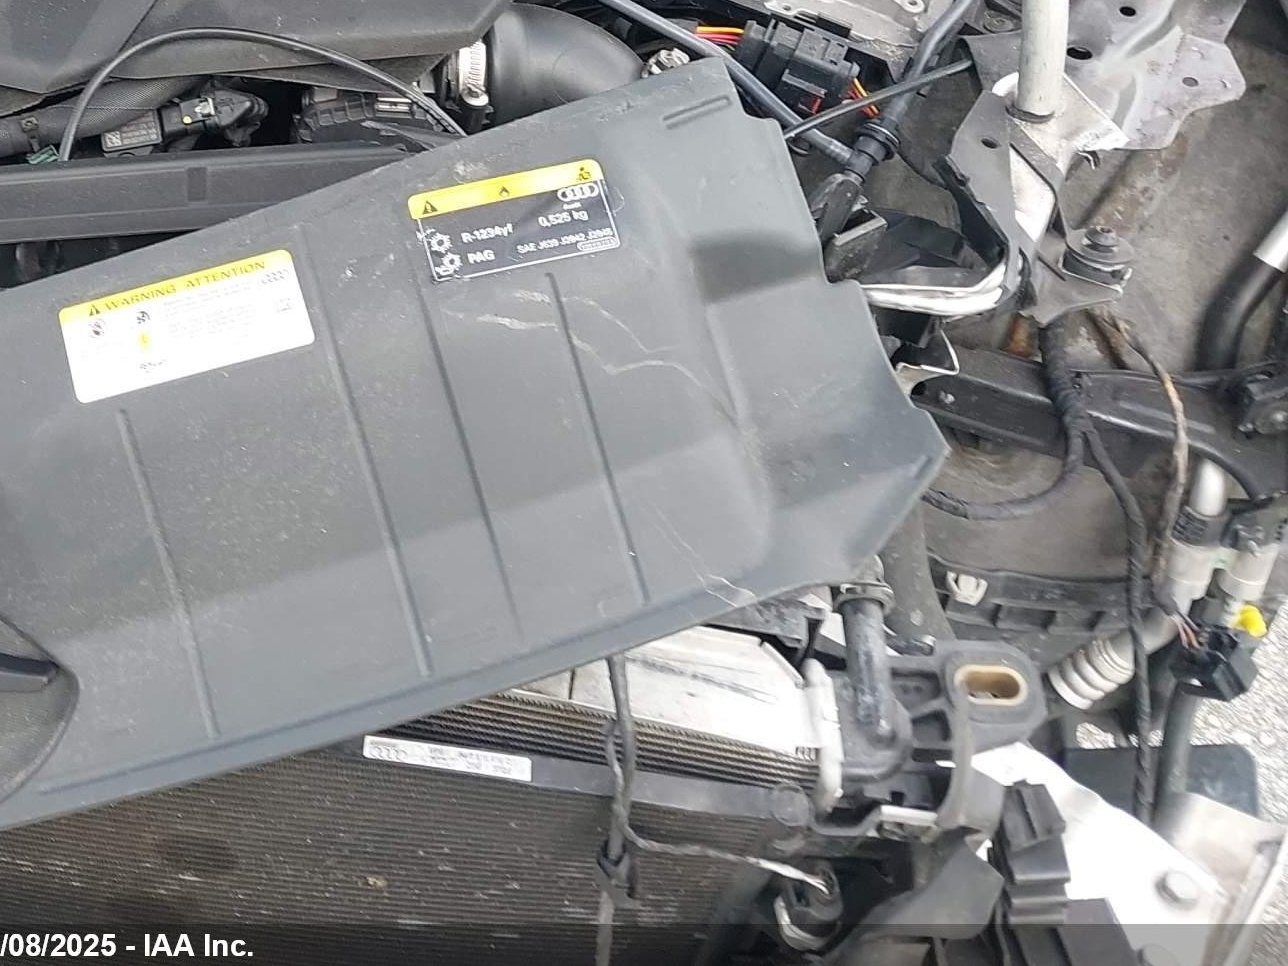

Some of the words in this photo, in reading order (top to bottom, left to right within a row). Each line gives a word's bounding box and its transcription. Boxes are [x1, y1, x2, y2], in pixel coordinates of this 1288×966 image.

[572, 210, 589, 221] kg
[461, 223, 513, 243] R-1234yf
[467, 249, 496, 264] PAG
[105, 284, 177, 312] WARNING
[185, 261, 265, 288] ATTENTION
